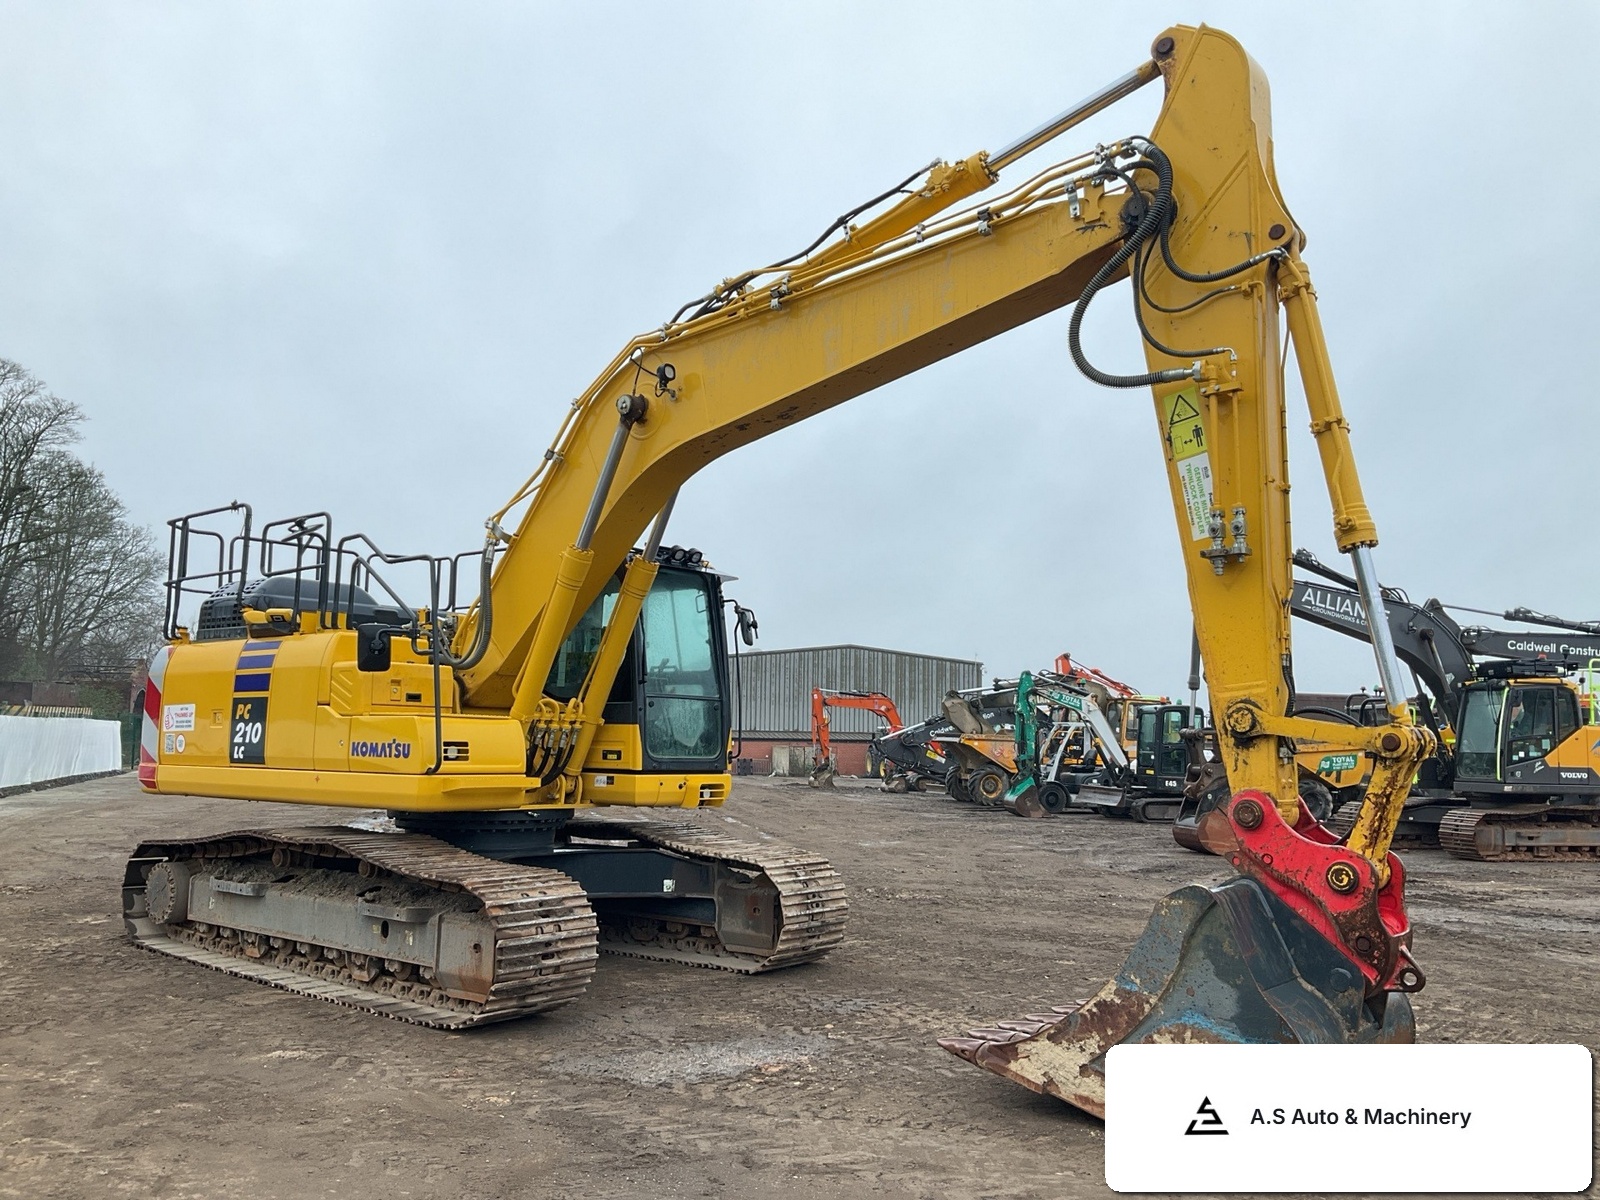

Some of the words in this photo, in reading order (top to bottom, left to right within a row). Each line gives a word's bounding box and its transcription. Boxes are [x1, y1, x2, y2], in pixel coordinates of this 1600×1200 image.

[1185, 463, 1198, 500] TWINLOCK
[1193, 502, 1205, 535] COUPLER
[1194, 466, 1206, 498] GENUINE
[1201, 500, 1211, 526] MILLER
[1301, 587, 1391, 620] ALLIAN
[1311, 606, 1356, 623] GROUNDWORKS
[1507, 640, 1556, 653] Caldwell
[1560, 644, 1600, 656] Constru
[1062, 694, 1081, 703] TOTAL
[235, 703, 252, 720] PC
[233, 721, 262, 744] 210
[233, 745, 245, 759] LC
[351, 741, 411, 759] KOMATSU
